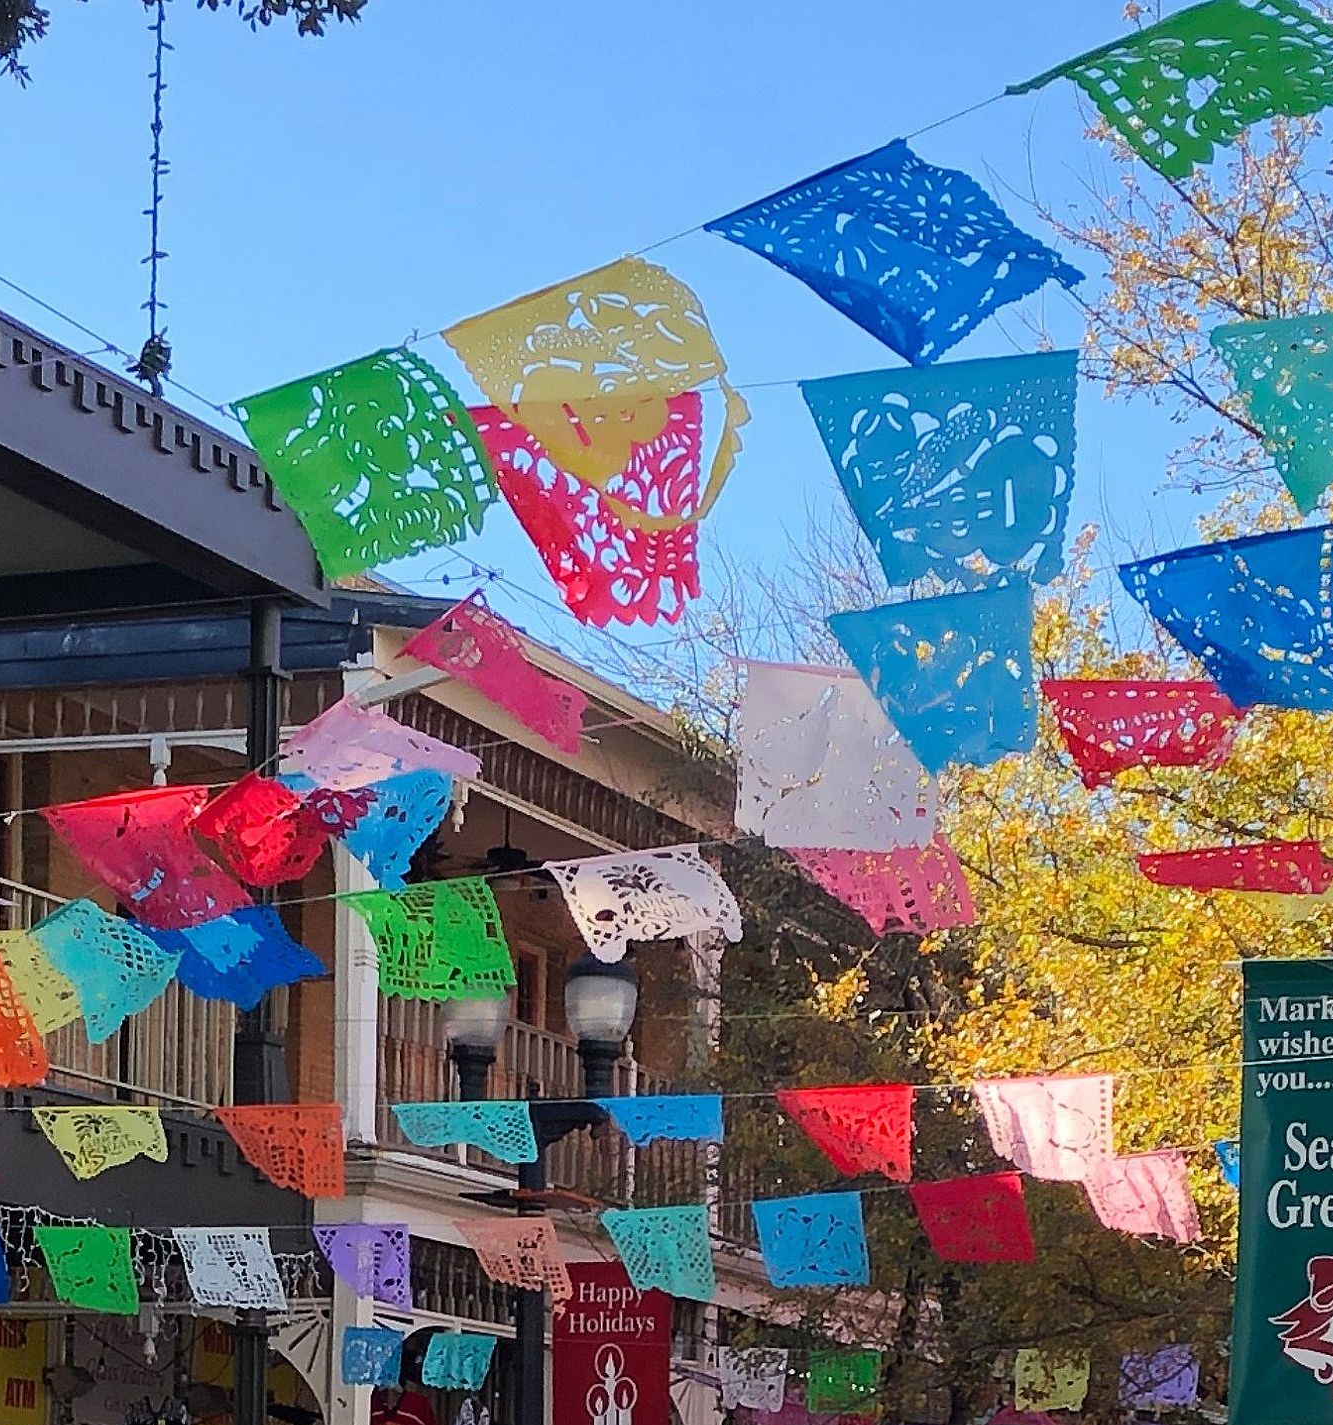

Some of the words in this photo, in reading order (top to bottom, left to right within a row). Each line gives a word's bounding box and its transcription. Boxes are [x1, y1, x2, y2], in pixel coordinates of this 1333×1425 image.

[578, 1282, 643, 1309] Happy
[568, 1311, 655, 1338] Holidays
[5, 1377, 36, 1409] ATM
